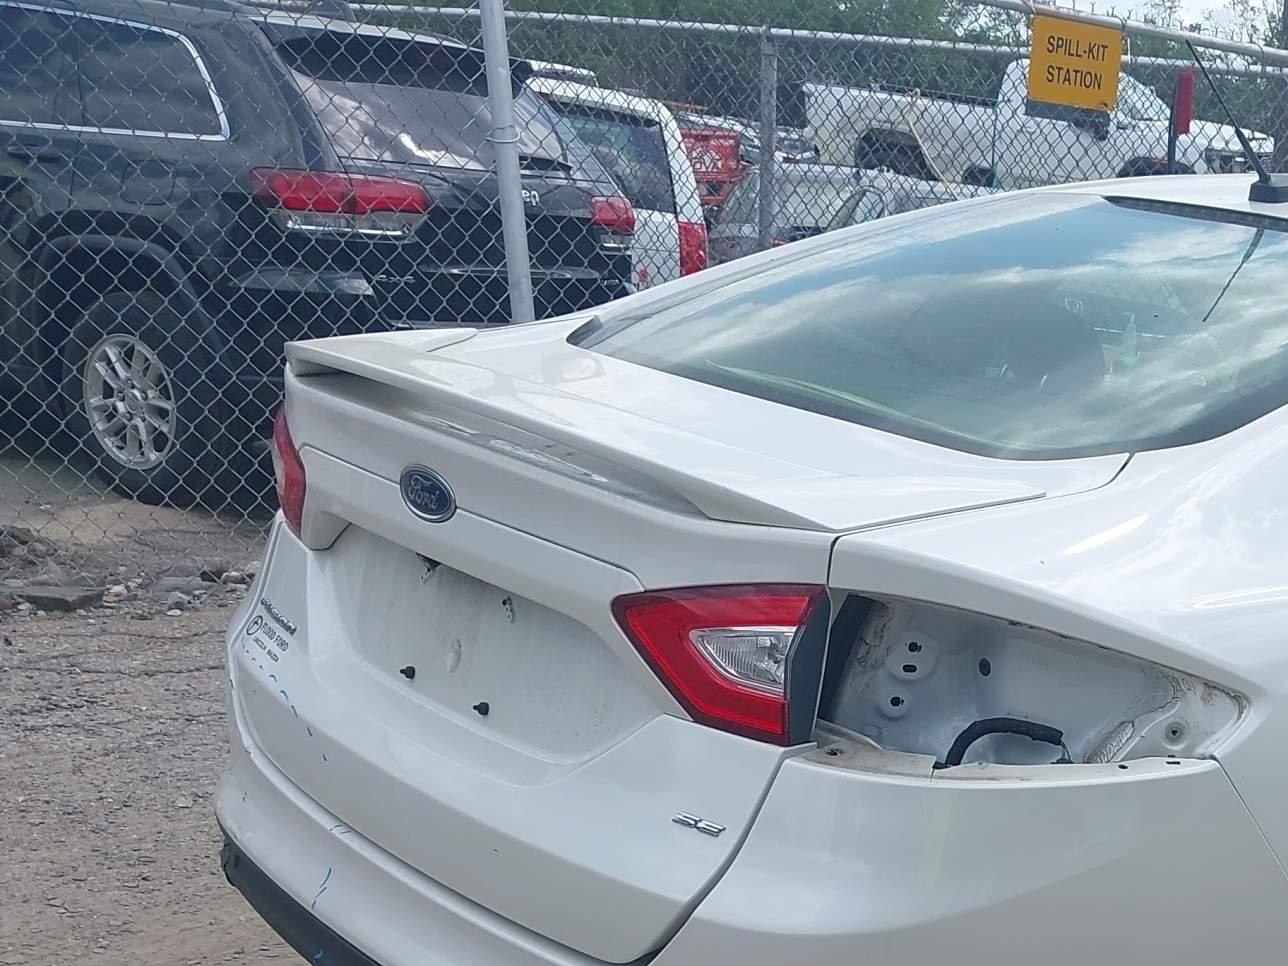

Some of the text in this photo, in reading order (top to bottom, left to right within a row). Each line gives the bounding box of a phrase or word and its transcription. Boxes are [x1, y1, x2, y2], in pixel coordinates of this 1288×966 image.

[1046, 35, 1109, 62] SPILL-KIT
[1046, 64, 1103, 91] STATION
[672, 811, 727, 838] SE
